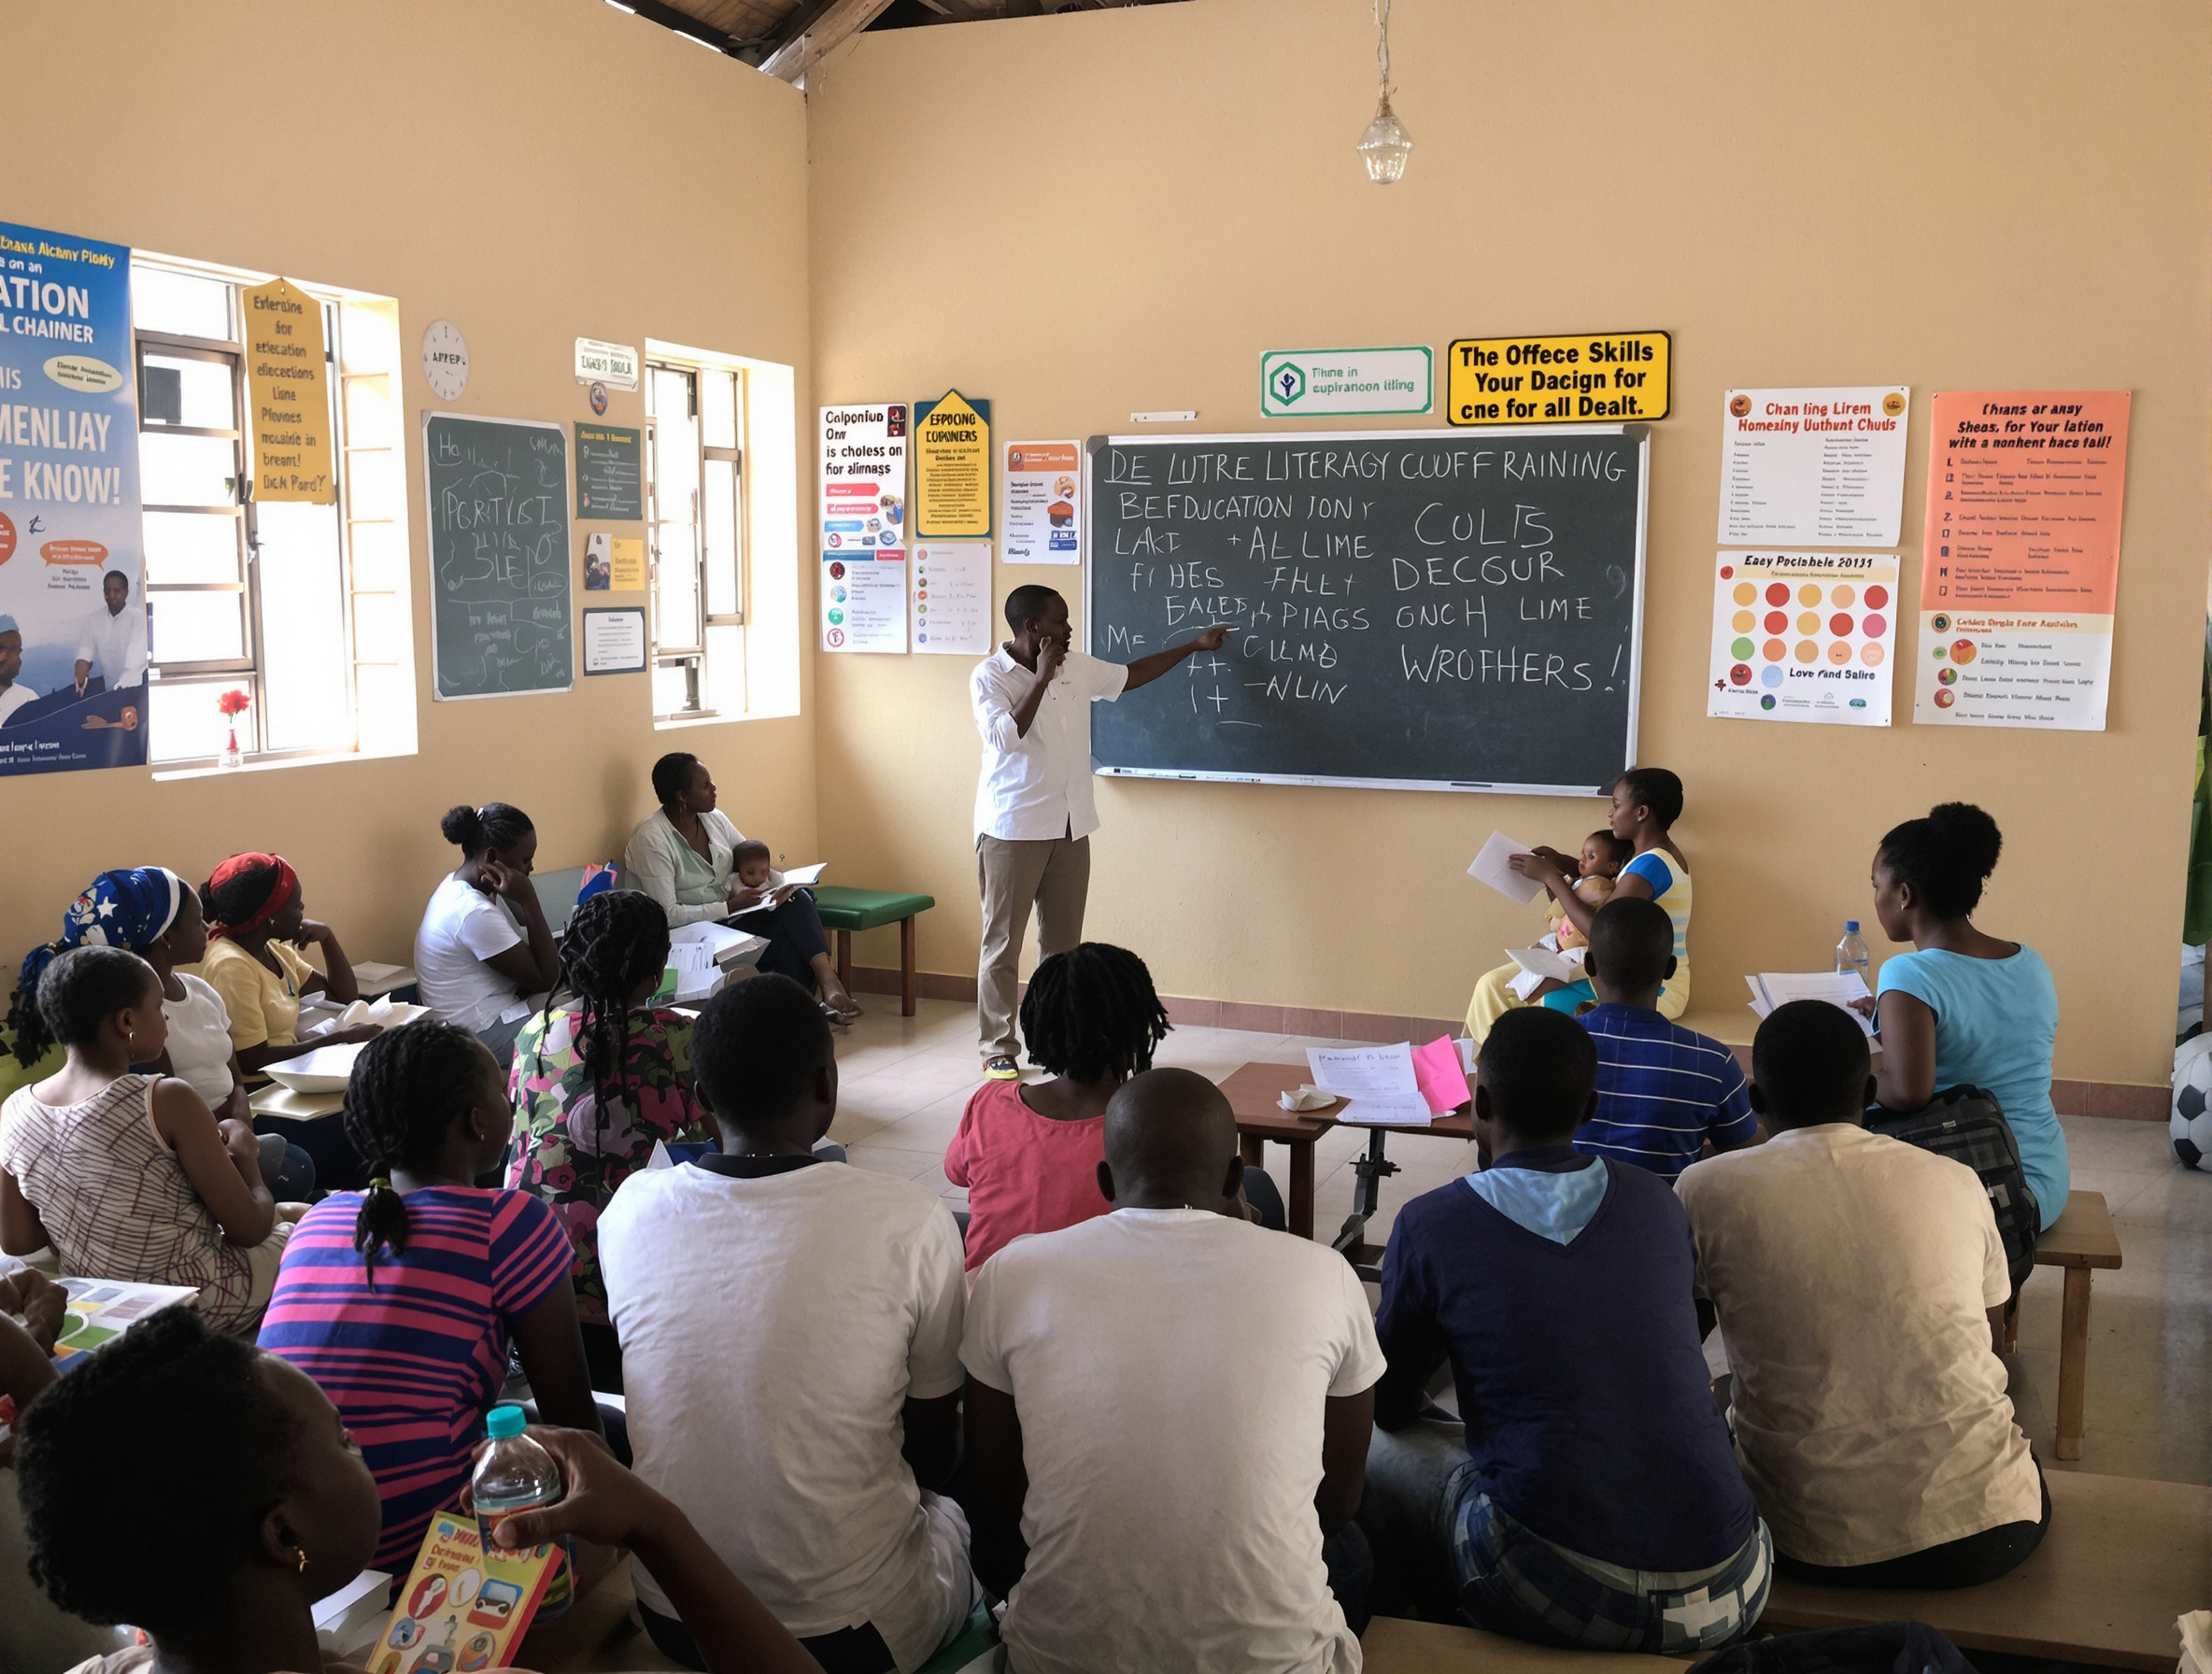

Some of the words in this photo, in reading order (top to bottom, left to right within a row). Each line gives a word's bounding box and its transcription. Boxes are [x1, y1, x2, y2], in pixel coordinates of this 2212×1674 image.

[28, 262, 42, 275] an
[1460, 346, 1499, 367] The
[1506, 344, 1580, 366] Offece
[1589, 340, 1653, 363] Skills
[1475, 372, 1524, 393] Your
[1531, 370, 1607, 394] Dacign
[1614, 367, 1647, 389] for
[1507, 398, 1538, 418] for
[1544, 397, 1570, 417] all
[1579, 394, 1644, 417] Dealt.
[2030, 420, 2060, 433] Your
[888, 447, 902, 457] on
[1108, 448, 1152, 484] DE
[1503, 449, 1627, 482] RAINING
[24, 461, 120, 504] KNOW!
[1520, 596, 1594, 621] LIME
